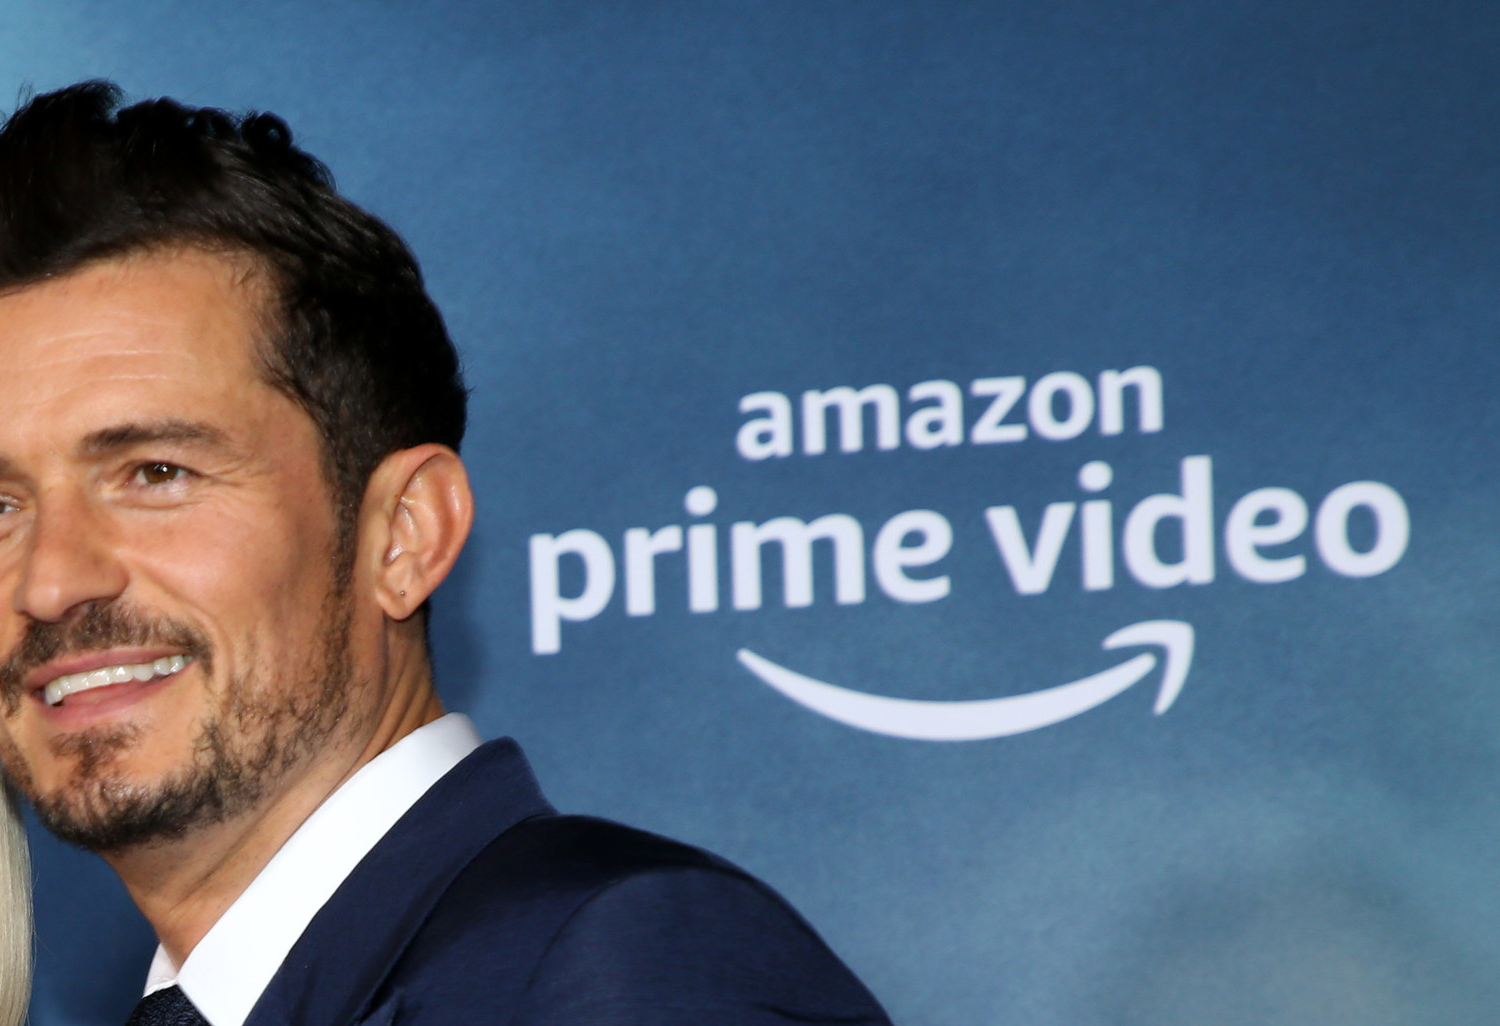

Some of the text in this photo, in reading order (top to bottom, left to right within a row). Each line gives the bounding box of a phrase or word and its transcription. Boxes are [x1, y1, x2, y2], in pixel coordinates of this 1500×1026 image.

[736, 364, 1164, 461] amazon
[529, 454, 1412, 655] prime video
